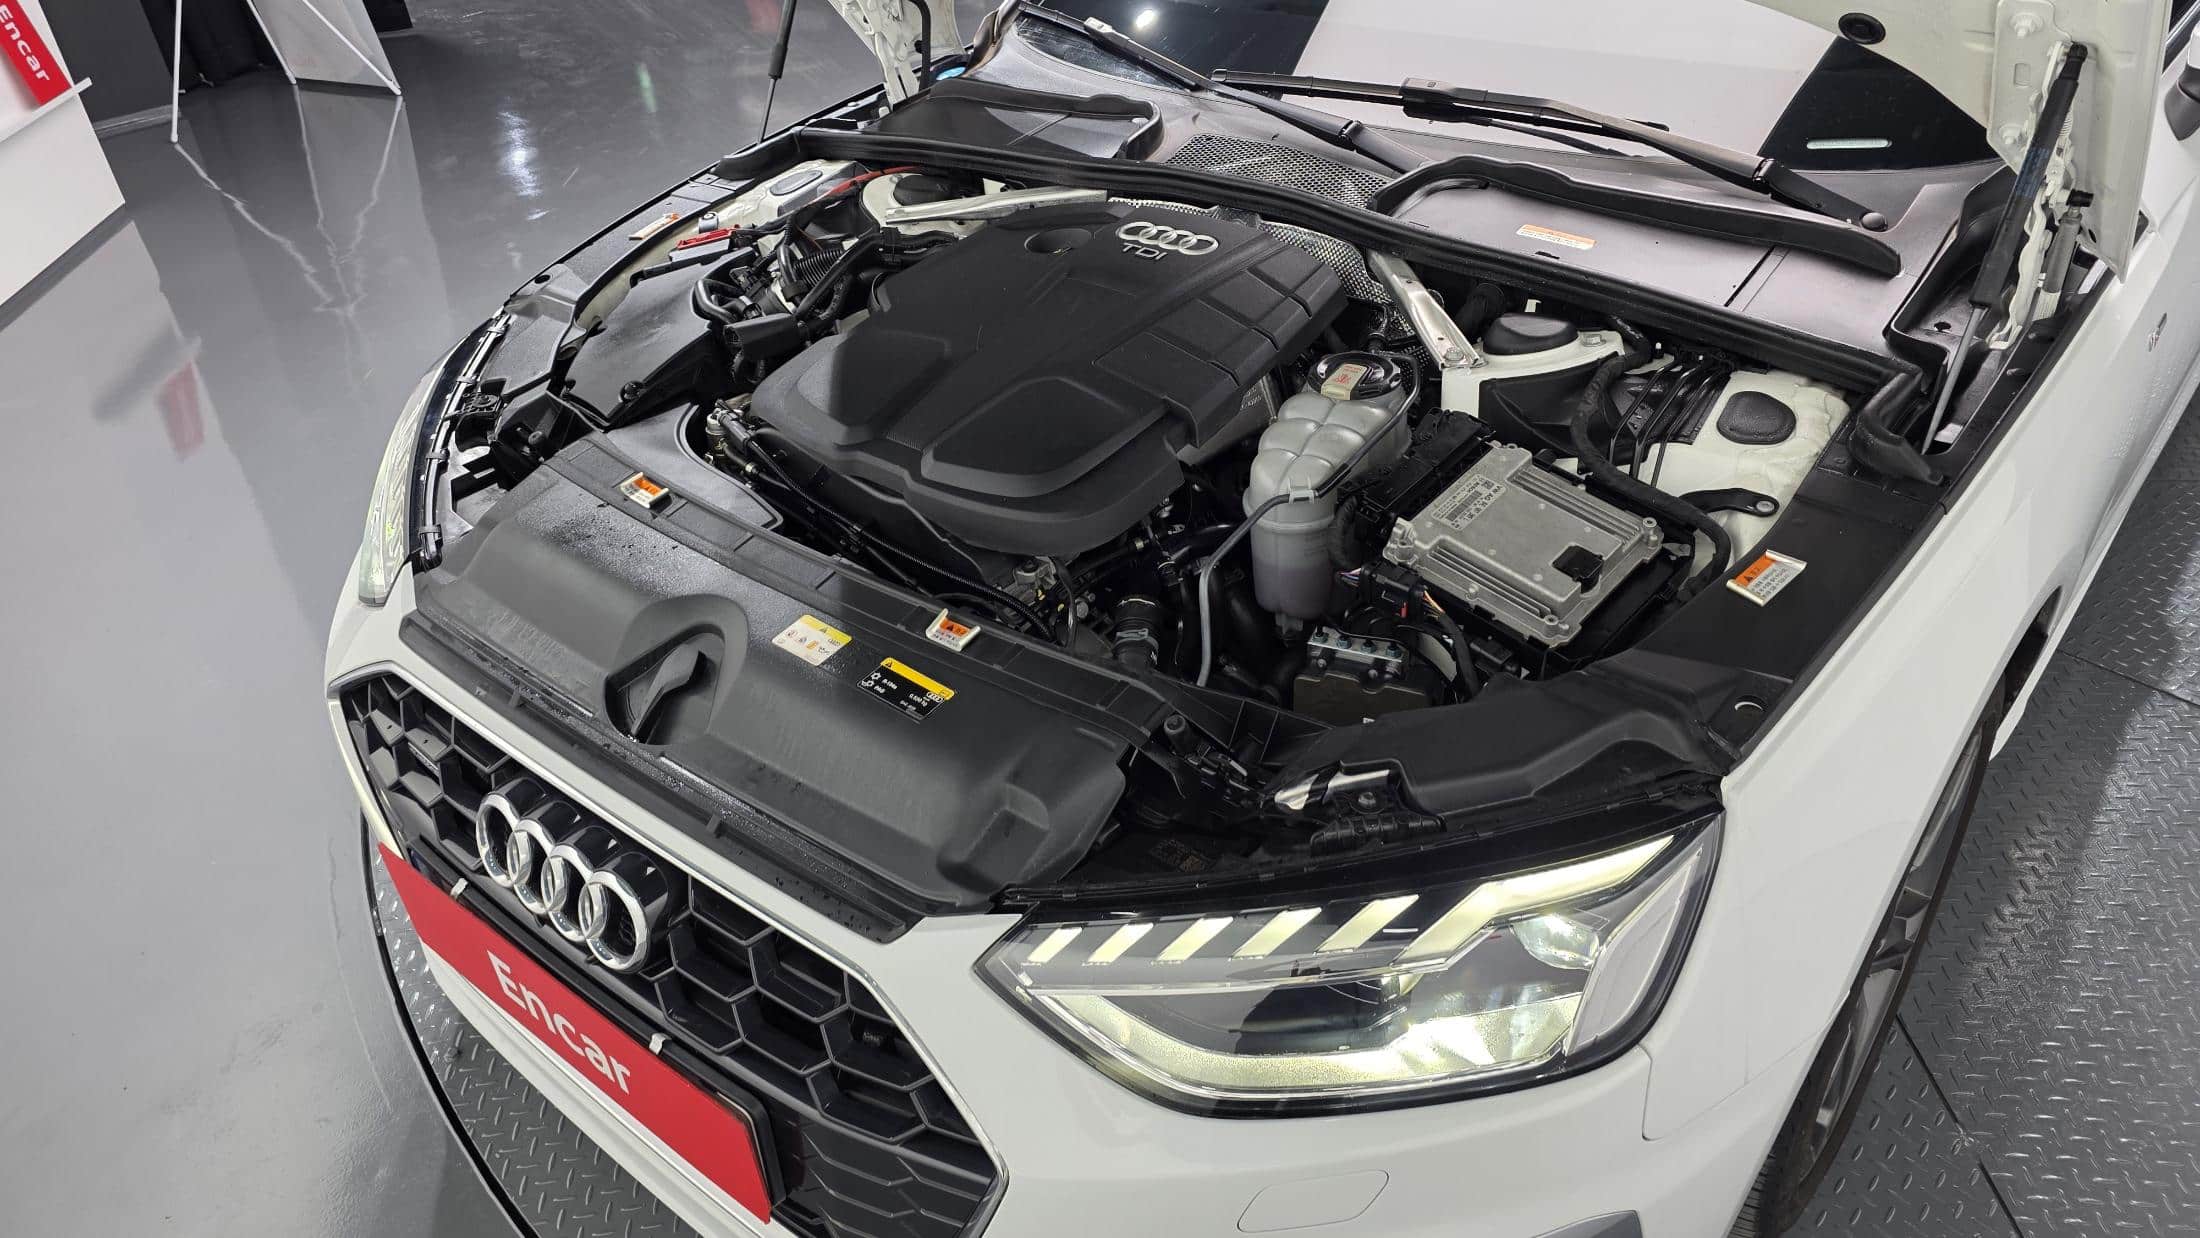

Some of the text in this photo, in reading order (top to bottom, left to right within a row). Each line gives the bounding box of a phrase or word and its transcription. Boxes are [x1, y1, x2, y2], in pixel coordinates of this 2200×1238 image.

[0, 4, 50, 81] Encar
[1122, 242, 1168, 260] TDI
[486, 949, 631, 1095] Encar
